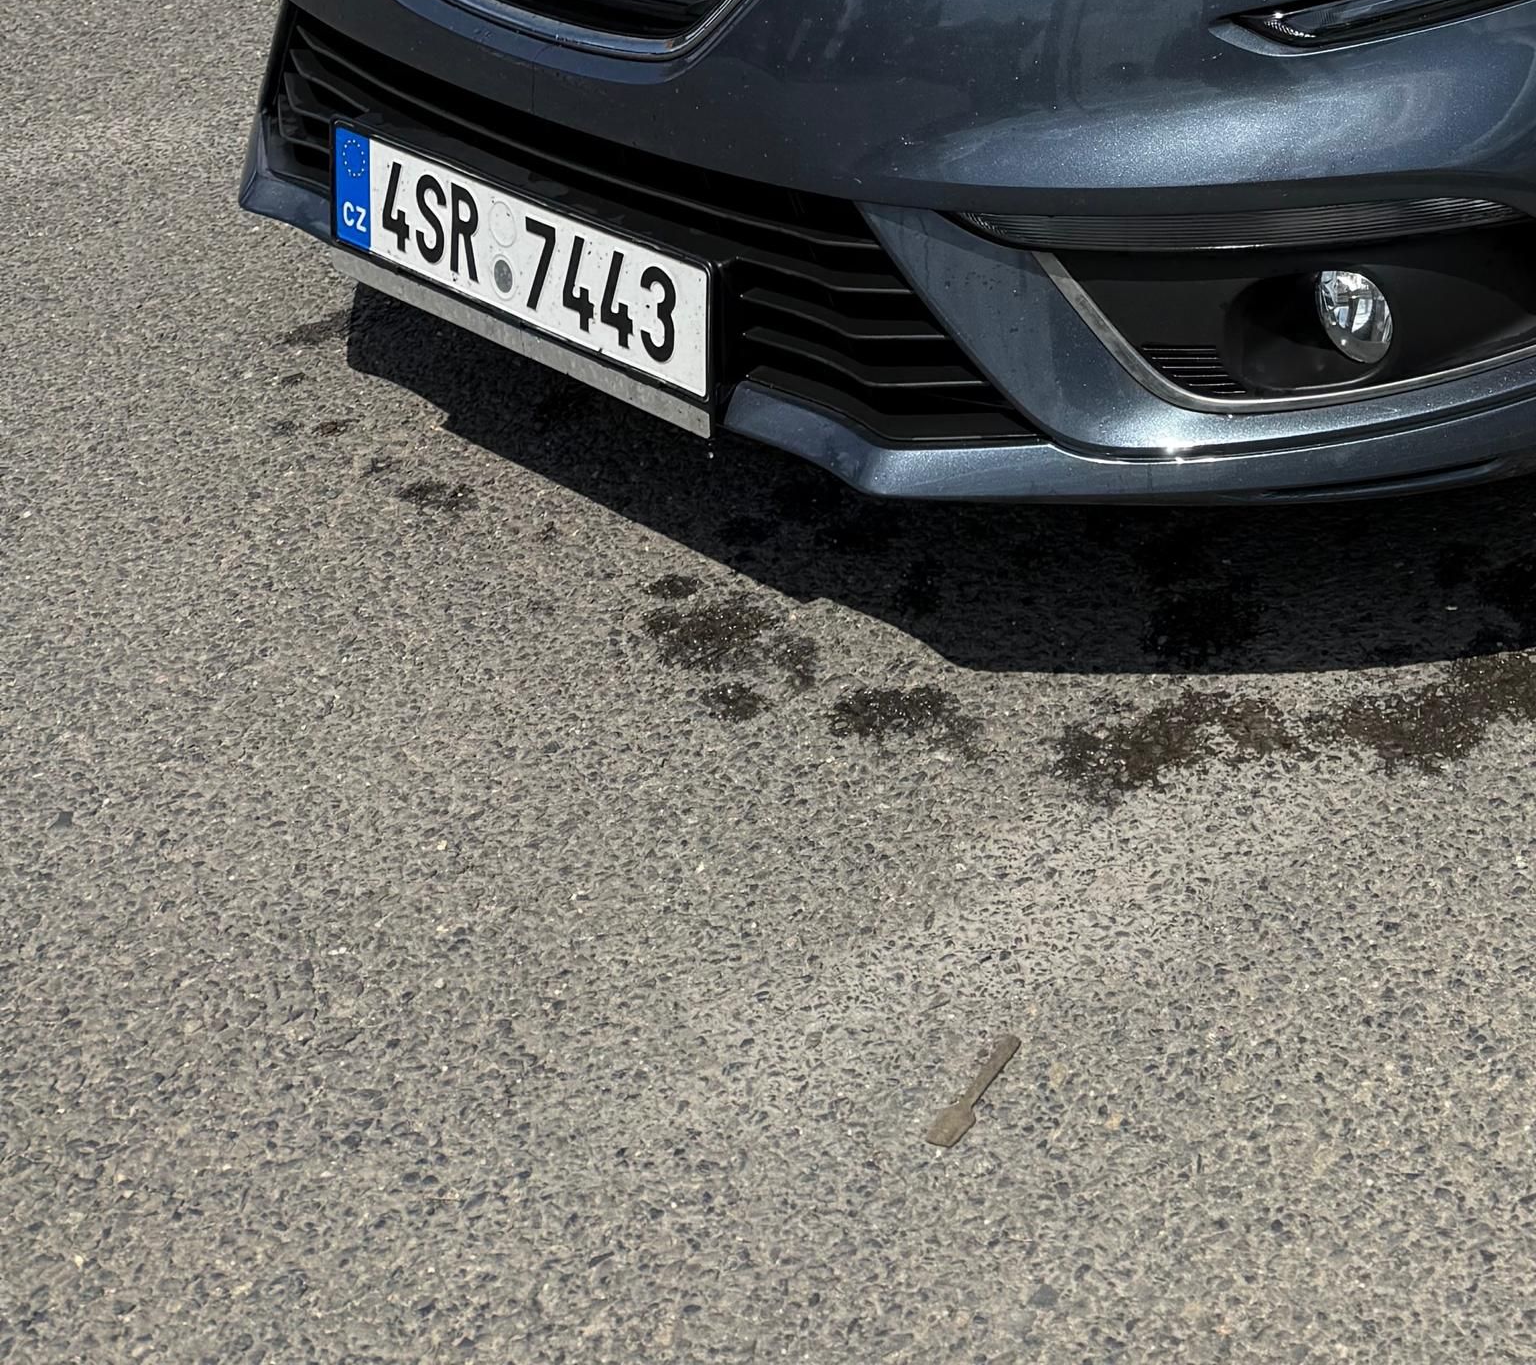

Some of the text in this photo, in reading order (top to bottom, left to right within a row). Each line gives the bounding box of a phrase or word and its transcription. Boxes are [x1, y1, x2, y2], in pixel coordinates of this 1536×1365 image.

[342, 201, 367, 232] CZ
[382, 161, 676, 363] 4SR 7443
